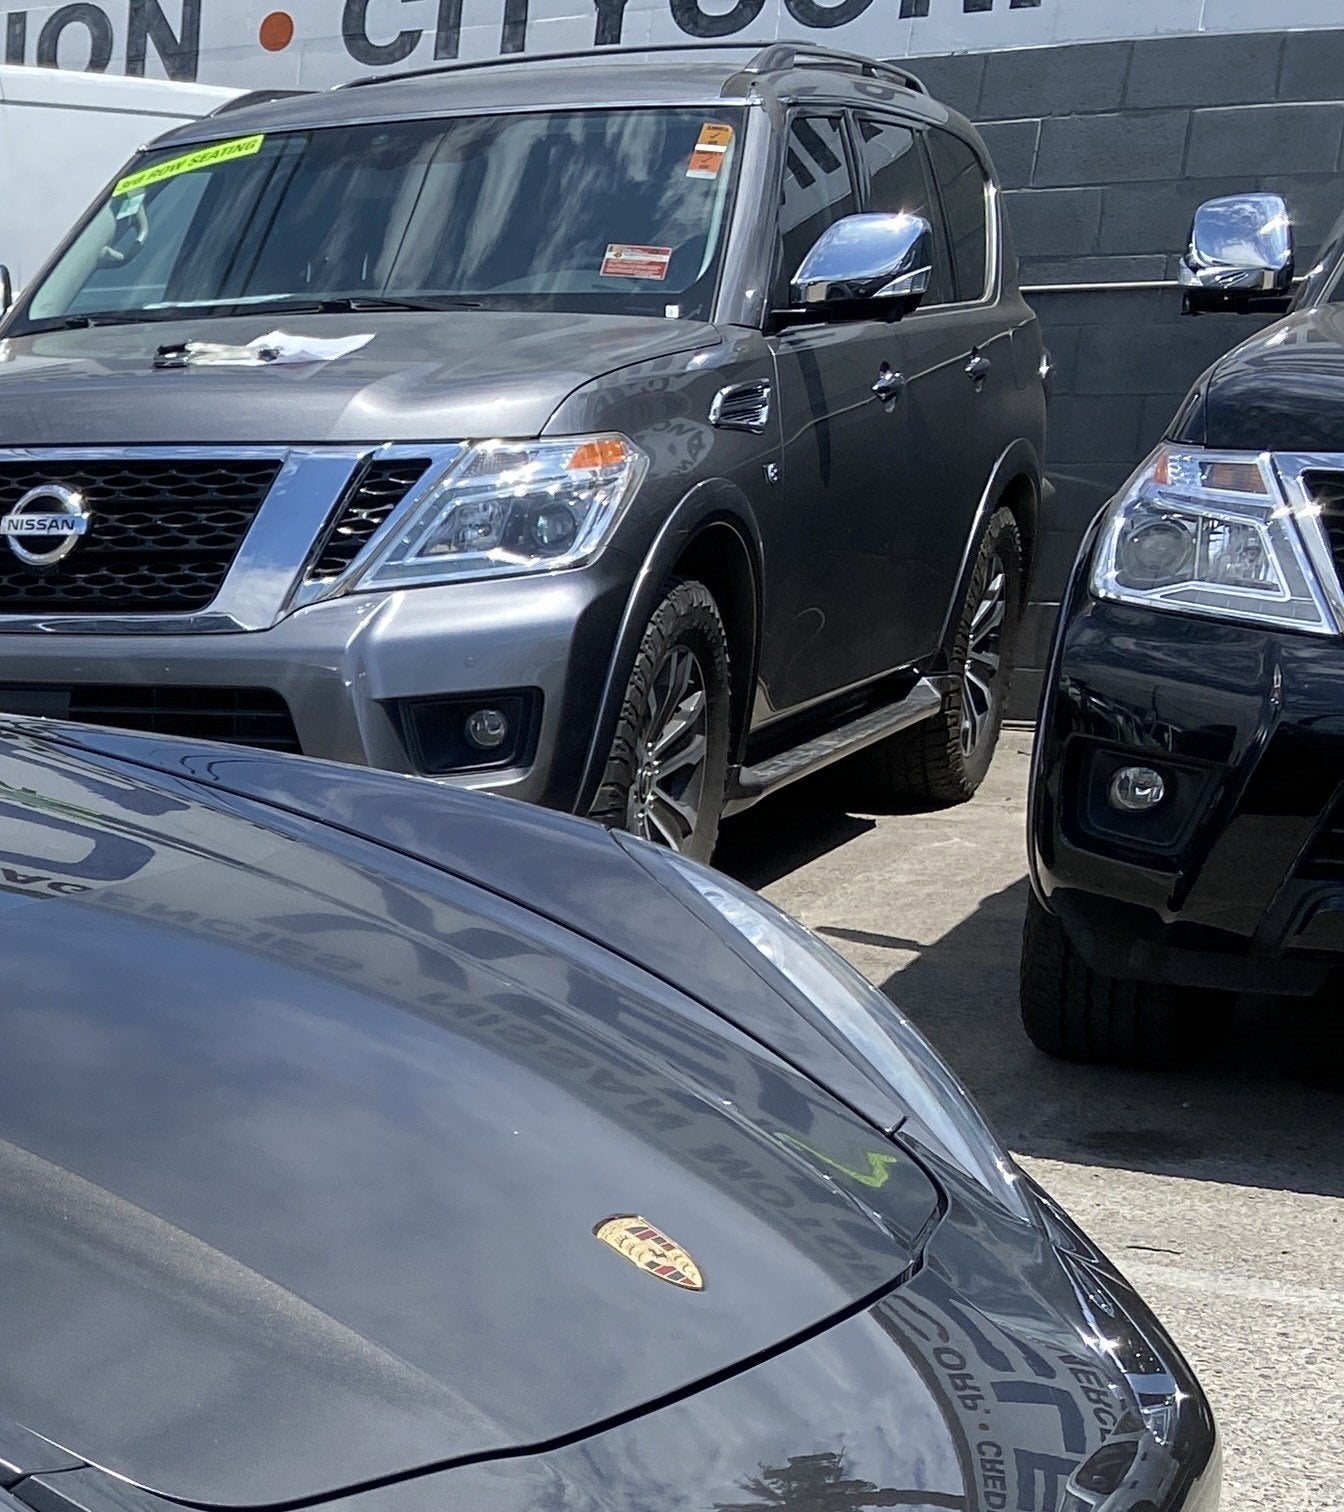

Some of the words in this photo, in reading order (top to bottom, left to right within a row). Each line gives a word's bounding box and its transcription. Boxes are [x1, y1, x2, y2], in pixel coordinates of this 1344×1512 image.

[145, 158, 187, 180] ROW
[187, 138, 259, 168] SEATING
[6, 518, 76, 531] NISSAN
